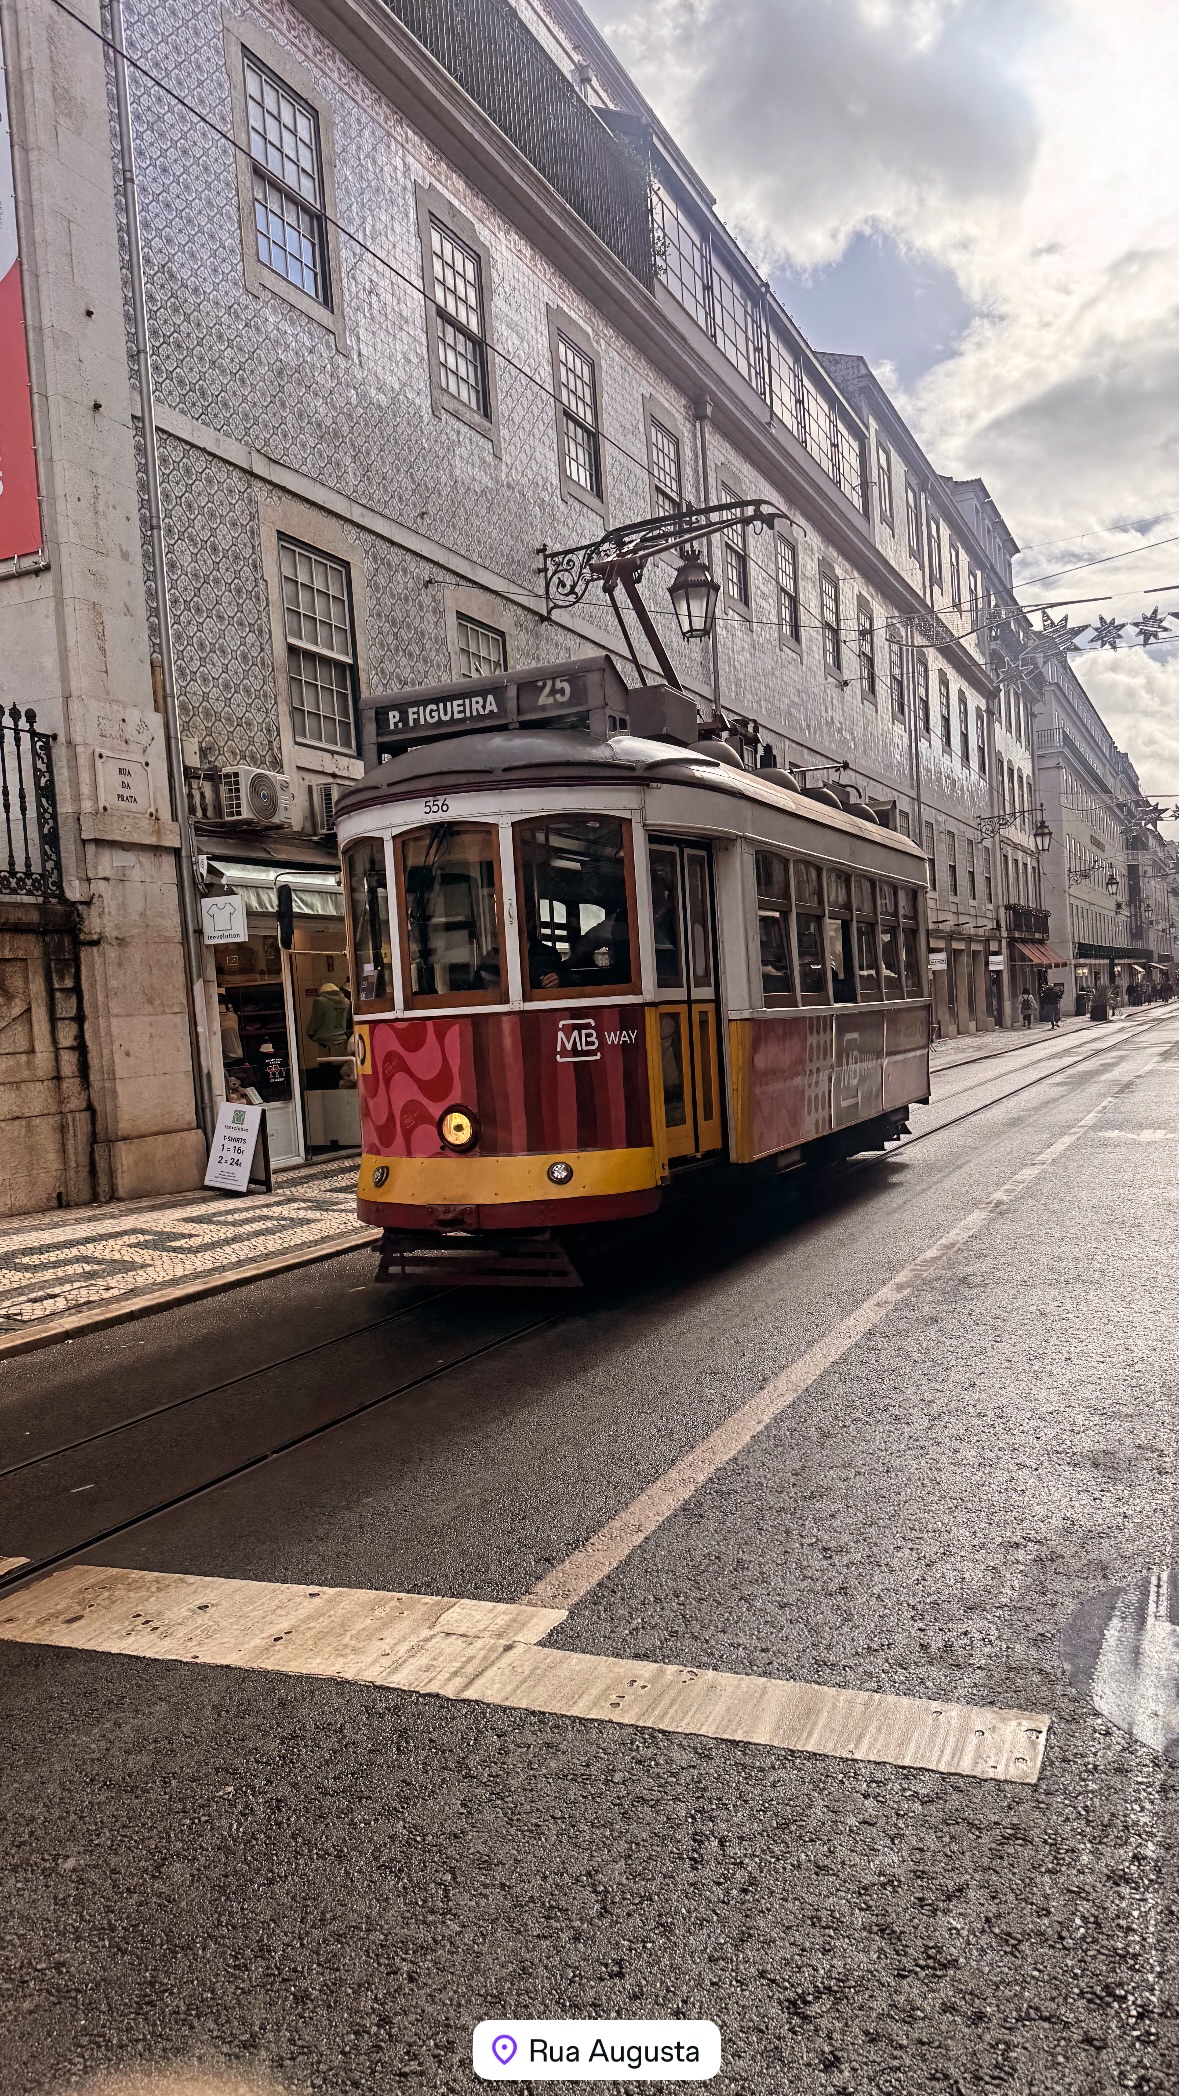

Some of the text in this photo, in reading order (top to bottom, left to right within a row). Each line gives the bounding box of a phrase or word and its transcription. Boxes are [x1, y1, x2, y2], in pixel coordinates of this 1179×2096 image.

[536, 677, 571, 706] 25
[389, 694, 498, 730] P. FIGUEIRA
[118, 767, 132, 777] RUA
[121, 780, 131, 790] DA
[116, 793, 138, 804] PRATA
[424, 798, 449, 814] 556
[556, 1029, 637, 1052] MB WAY
[223, 1135, 247, 1144] T-SHIRTS
[221, 1144, 225, 1152] 1
[217, 1156, 223, 1164] 2
